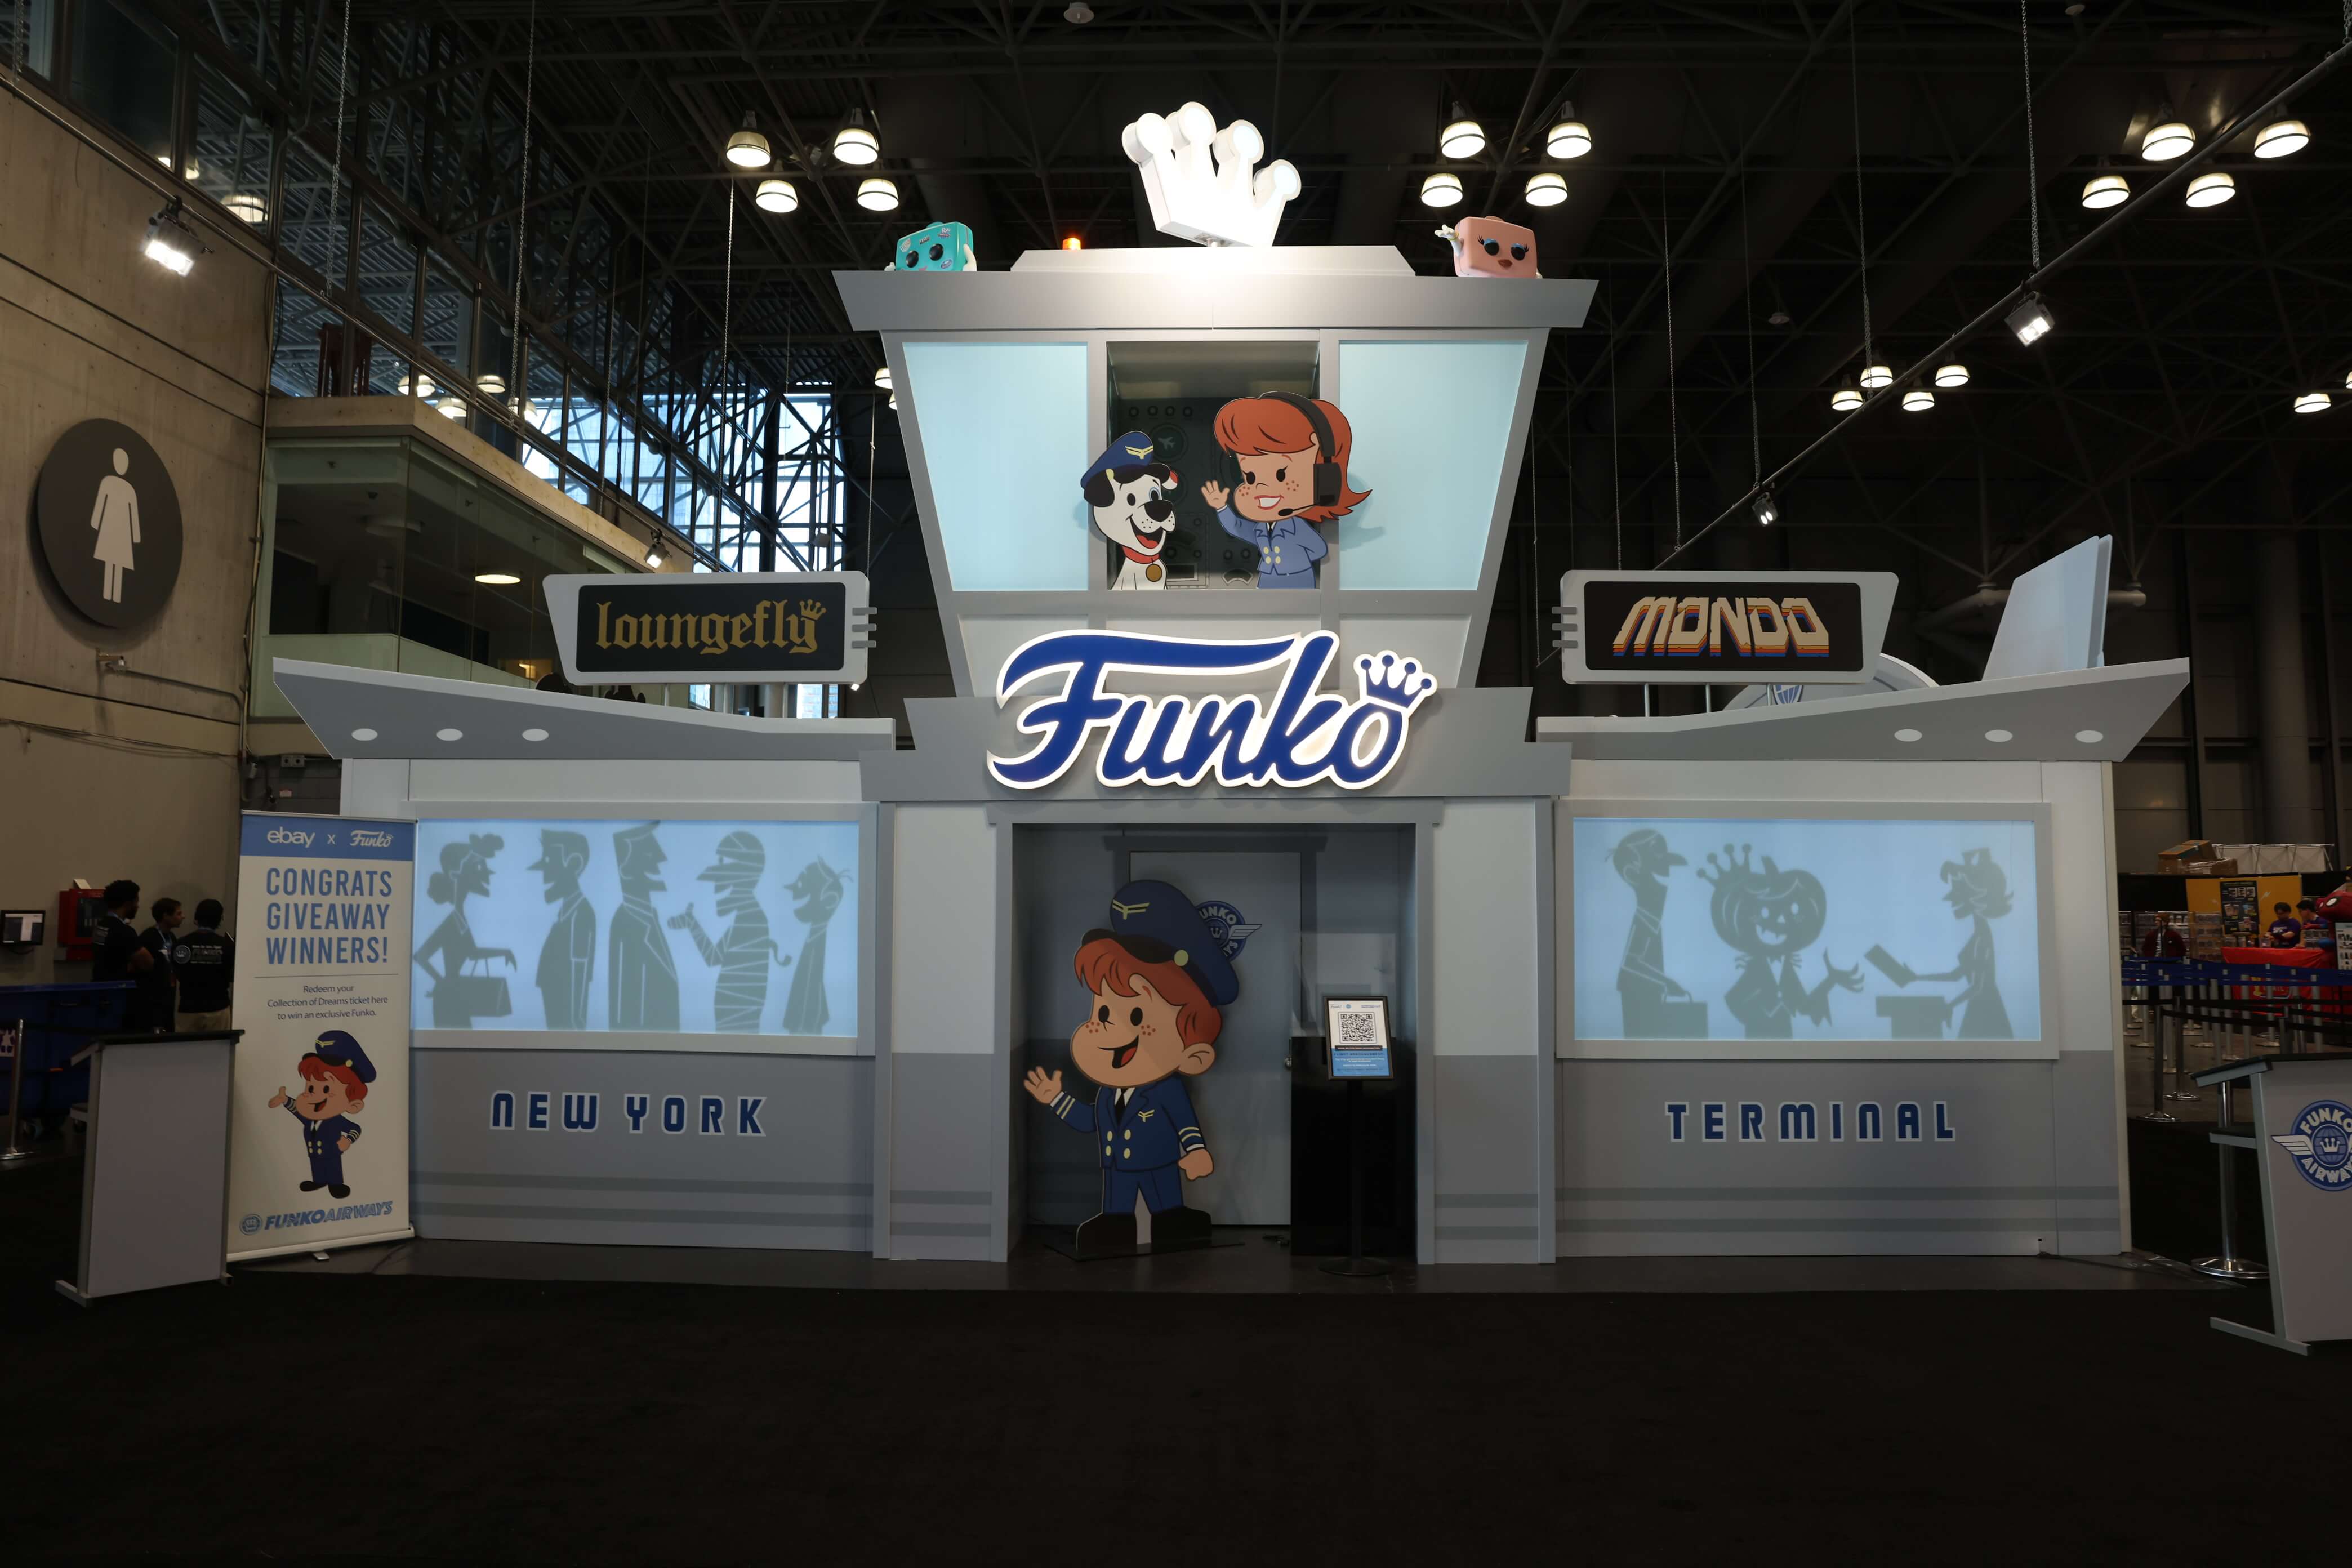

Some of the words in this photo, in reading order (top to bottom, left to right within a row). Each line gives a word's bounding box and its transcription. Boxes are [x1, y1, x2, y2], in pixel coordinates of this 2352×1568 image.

[596, 599, 826, 655] loungefly
[1612, 596, 1830, 657] MONDO
[986, 629, 1438, 790] Funko
[266, 826, 315, 848] ebay
[350, 830, 393, 847] Funko
[266, 867, 392, 897] CONGRATS
[266, 902, 390, 930] GIVEAWAY
[1197, 906, 1237, 925] UNKO
[266, 937, 387, 964] WINNERS!
[268, 999, 308, 1008] Collection
[337, 986, 354, 994] your
[490, 1091, 599, 1132] NEW
[624, 1094, 767, 1137] YORK
[1665, 1101, 1955, 1142] TERMINAL
[2300, 1108, 2352, 1135] FUNKO
